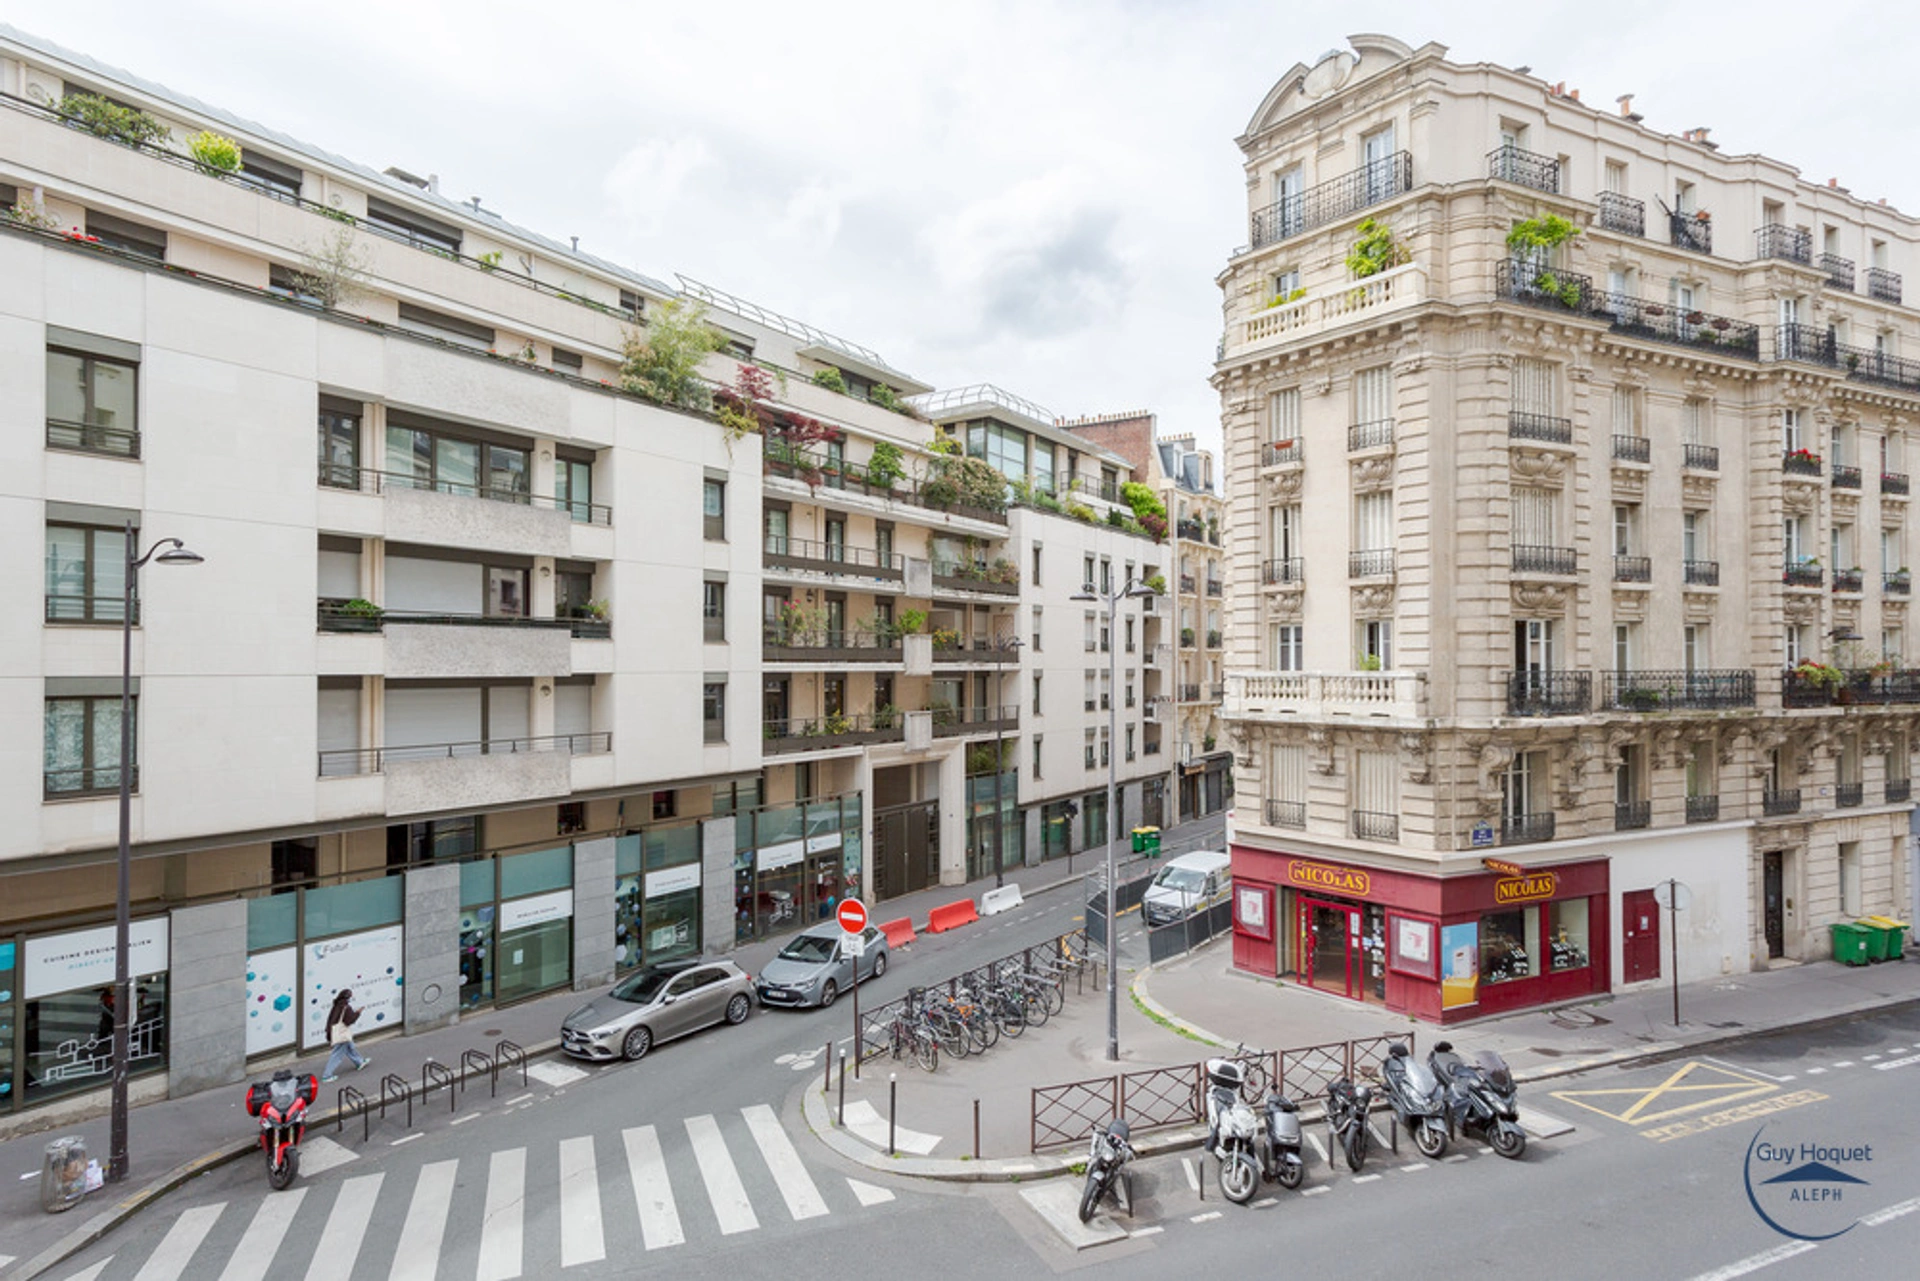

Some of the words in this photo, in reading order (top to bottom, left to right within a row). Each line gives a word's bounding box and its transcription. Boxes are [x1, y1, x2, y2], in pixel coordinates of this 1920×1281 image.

[1294, 866, 1365, 890] NICOLAS
[1499, 877, 1551, 899] NICOLAS
[43, 952, 80, 964] CUISINE
